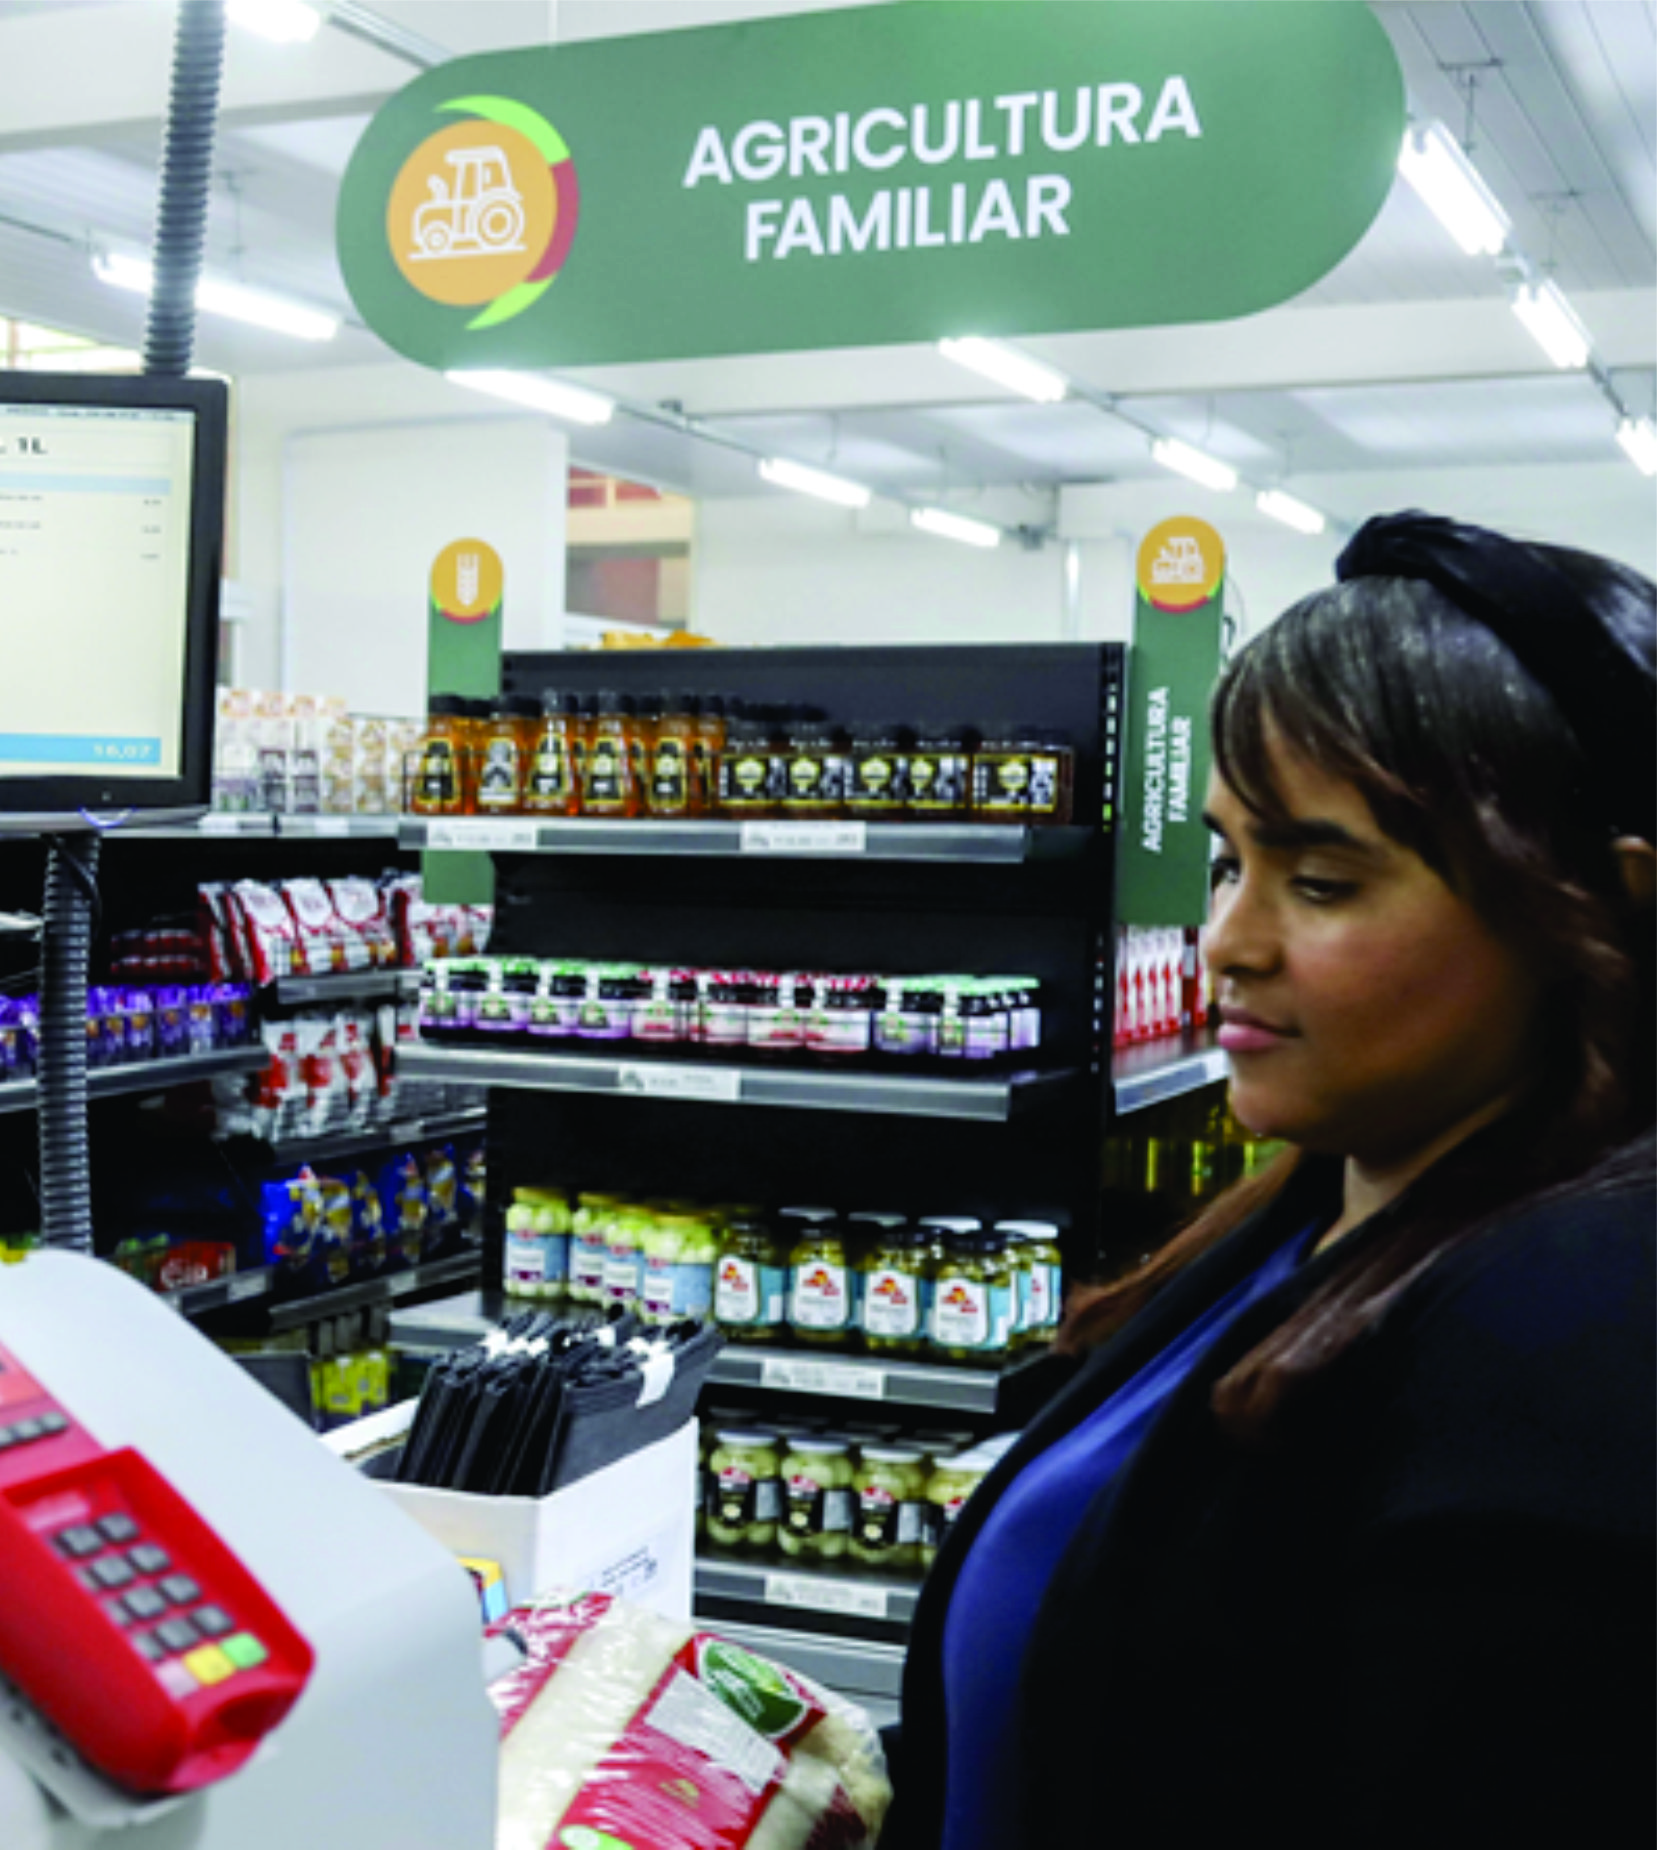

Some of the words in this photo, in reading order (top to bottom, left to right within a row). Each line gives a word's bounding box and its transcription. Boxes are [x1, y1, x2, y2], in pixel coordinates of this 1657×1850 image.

[681, 75, 1204, 188] AGRICULTURA
[745, 173, 1073, 261] FAMILIAR
[17, 437, 48, 455] 1L
[1142, 687, 1169, 852] AGRICULTURA
[1169, 717, 1191, 822] FAMILIAR
